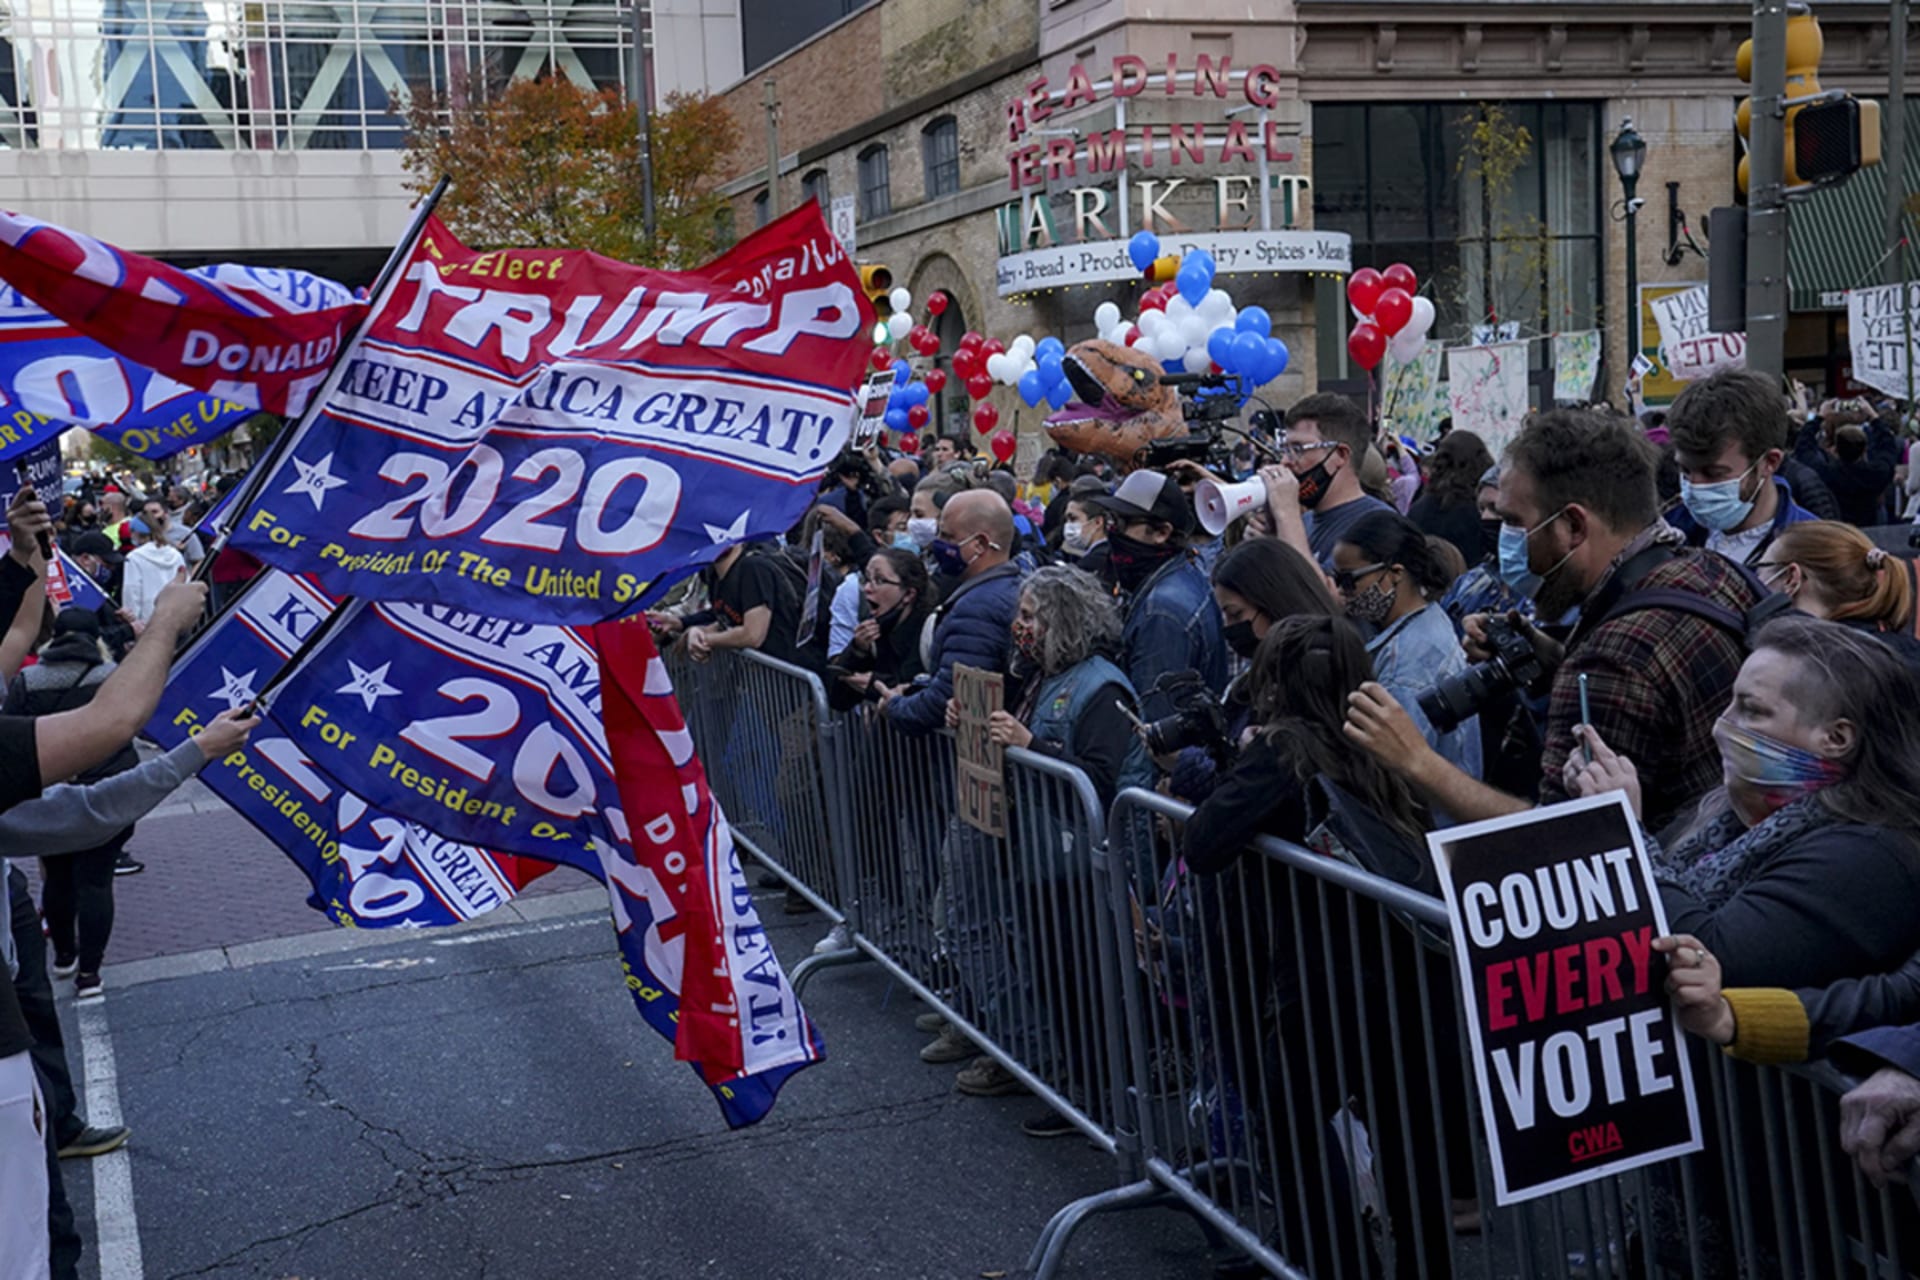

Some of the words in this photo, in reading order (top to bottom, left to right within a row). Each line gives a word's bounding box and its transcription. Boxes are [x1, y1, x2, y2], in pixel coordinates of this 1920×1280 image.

[1005, 52, 1281, 142] READING
[1005, 120, 1294, 191] TERMINAL
[995, 175, 1311, 254] MARKET
[1024, 256, 1065, 280] Bread
[1079, 249, 1137, 273] Produ
[1179, 244, 1239, 266] Diry
[1255, 240, 1306, 265] Spices
[396, 258, 861, 363] TRUMP
[337, 357, 449, 417] KEEP
[457, 370, 622, 431] ARICA
[632, 391, 837, 460] GREAT!
[348, 444, 682, 556] 2020
[248, 509, 306, 549] For
[421, 550, 451, 574] Of
[456, 550, 512, 587] The
[524, 565, 602, 600] United
[173, 708, 205, 738] Fo
[301, 704, 356, 751] For
[368, 743, 517, 826] President
[223, 751, 328, 847] President
[1462, 847, 1640, 949] COUNT
[1485, 925, 1653, 1032] EVERY
[1491, 1007, 1674, 1131] VOTE
[1567, 1121, 1623, 1160] CWA
